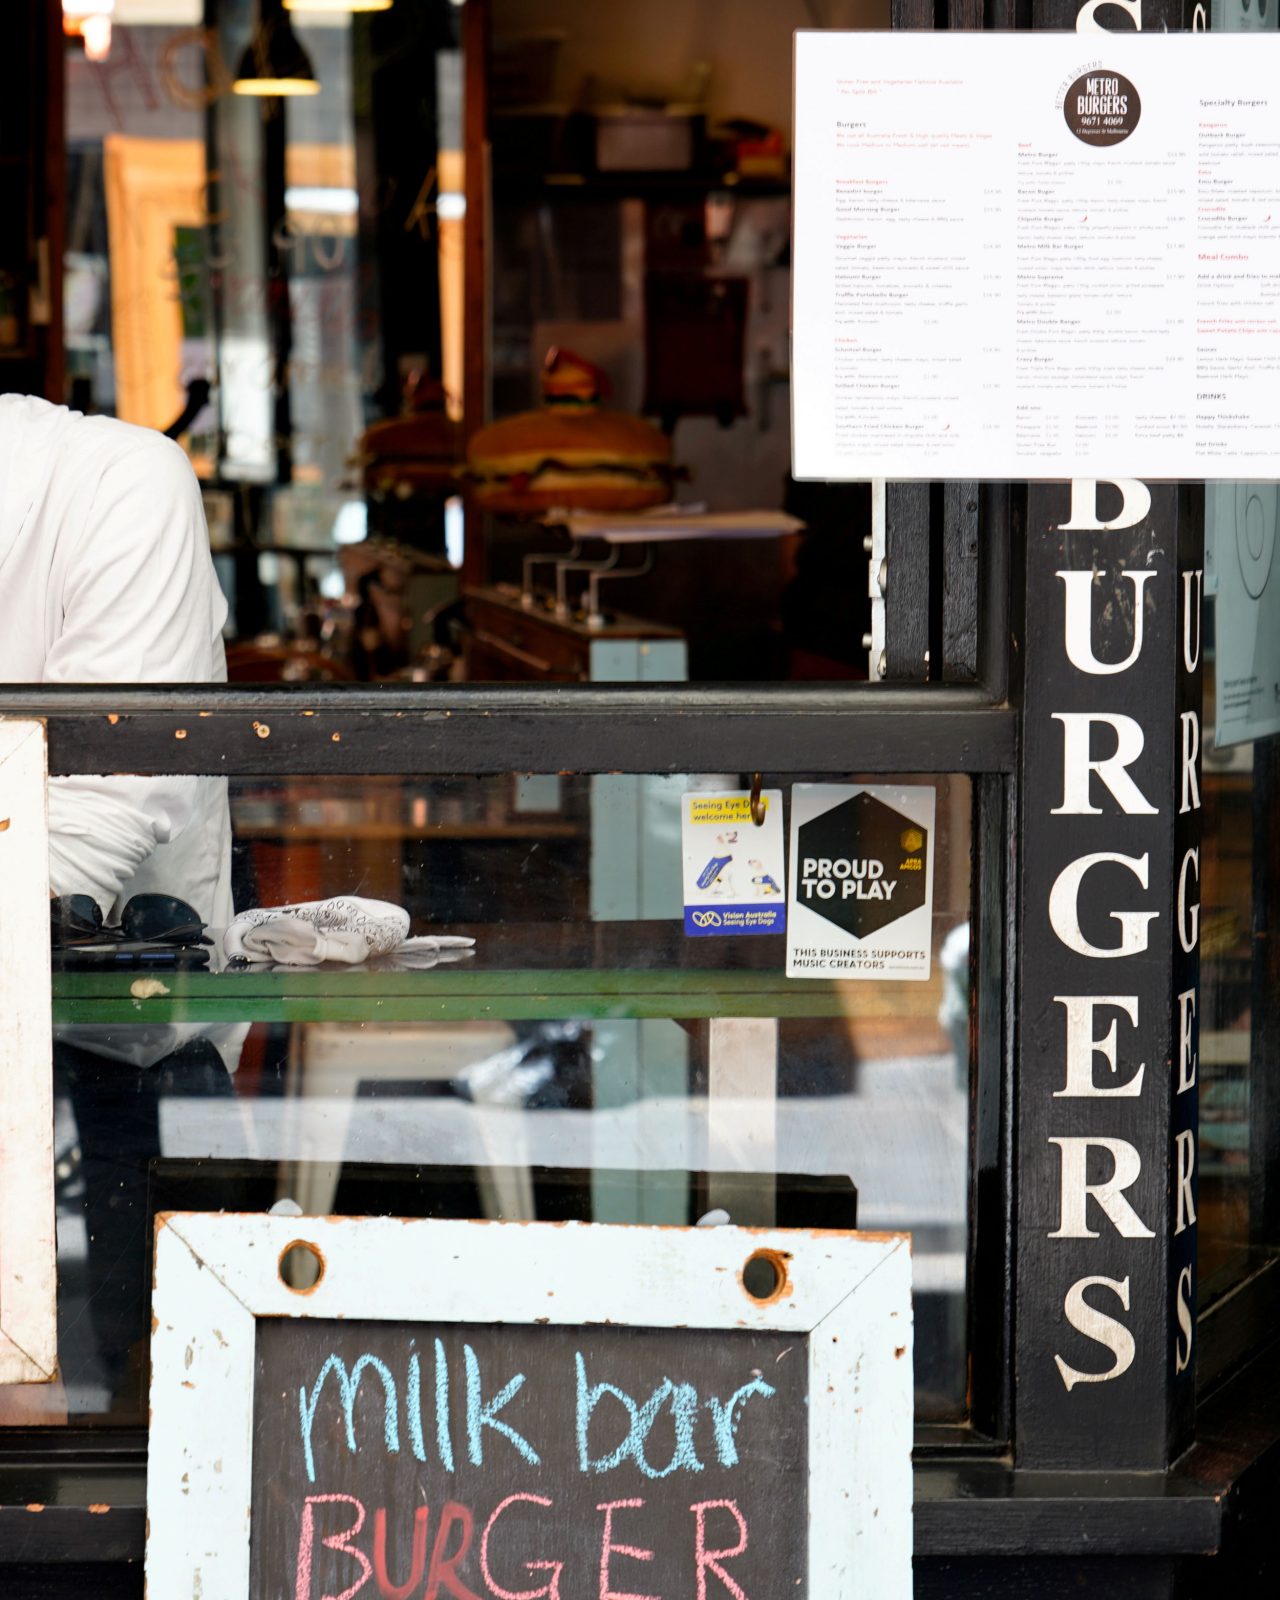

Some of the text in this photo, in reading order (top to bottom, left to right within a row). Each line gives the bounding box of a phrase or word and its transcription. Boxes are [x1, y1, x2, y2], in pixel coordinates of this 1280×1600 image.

[1087, 78, 1118, 95] METRO
[1077, 95, 1127, 115] BURGERS
[1200, 99, 1267, 108] Specialty Burgers
[836, 121, 866, 129] Burgers
[1081, 116, 1123, 125] 9671 4069
[1063, 243, 1084, 251] Burger
[1198, 253, 1218, 261] Meal
[693, 800, 723, 811] Seeing
[725, 800, 740, 811] Eye
[694, 812, 751, 821] welcome her
[804, 858, 883, 879] PROUD
[802, 879, 897, 900] TO PLAY
[723, 910, 776, 919] Vision Australia
[723, 918, 745, 927] Seeing
[758, 918, 775, 926] Dogs
[793, 948, 926, 959] THIS BUSINESS SUPPORTS
[793, 959, 826, 968] MUSIC
[829, 959, 885, 969] CREATORS
[576, 1352, 775, 1478] bar
[296, 1493, 746, 1600] BURGER
